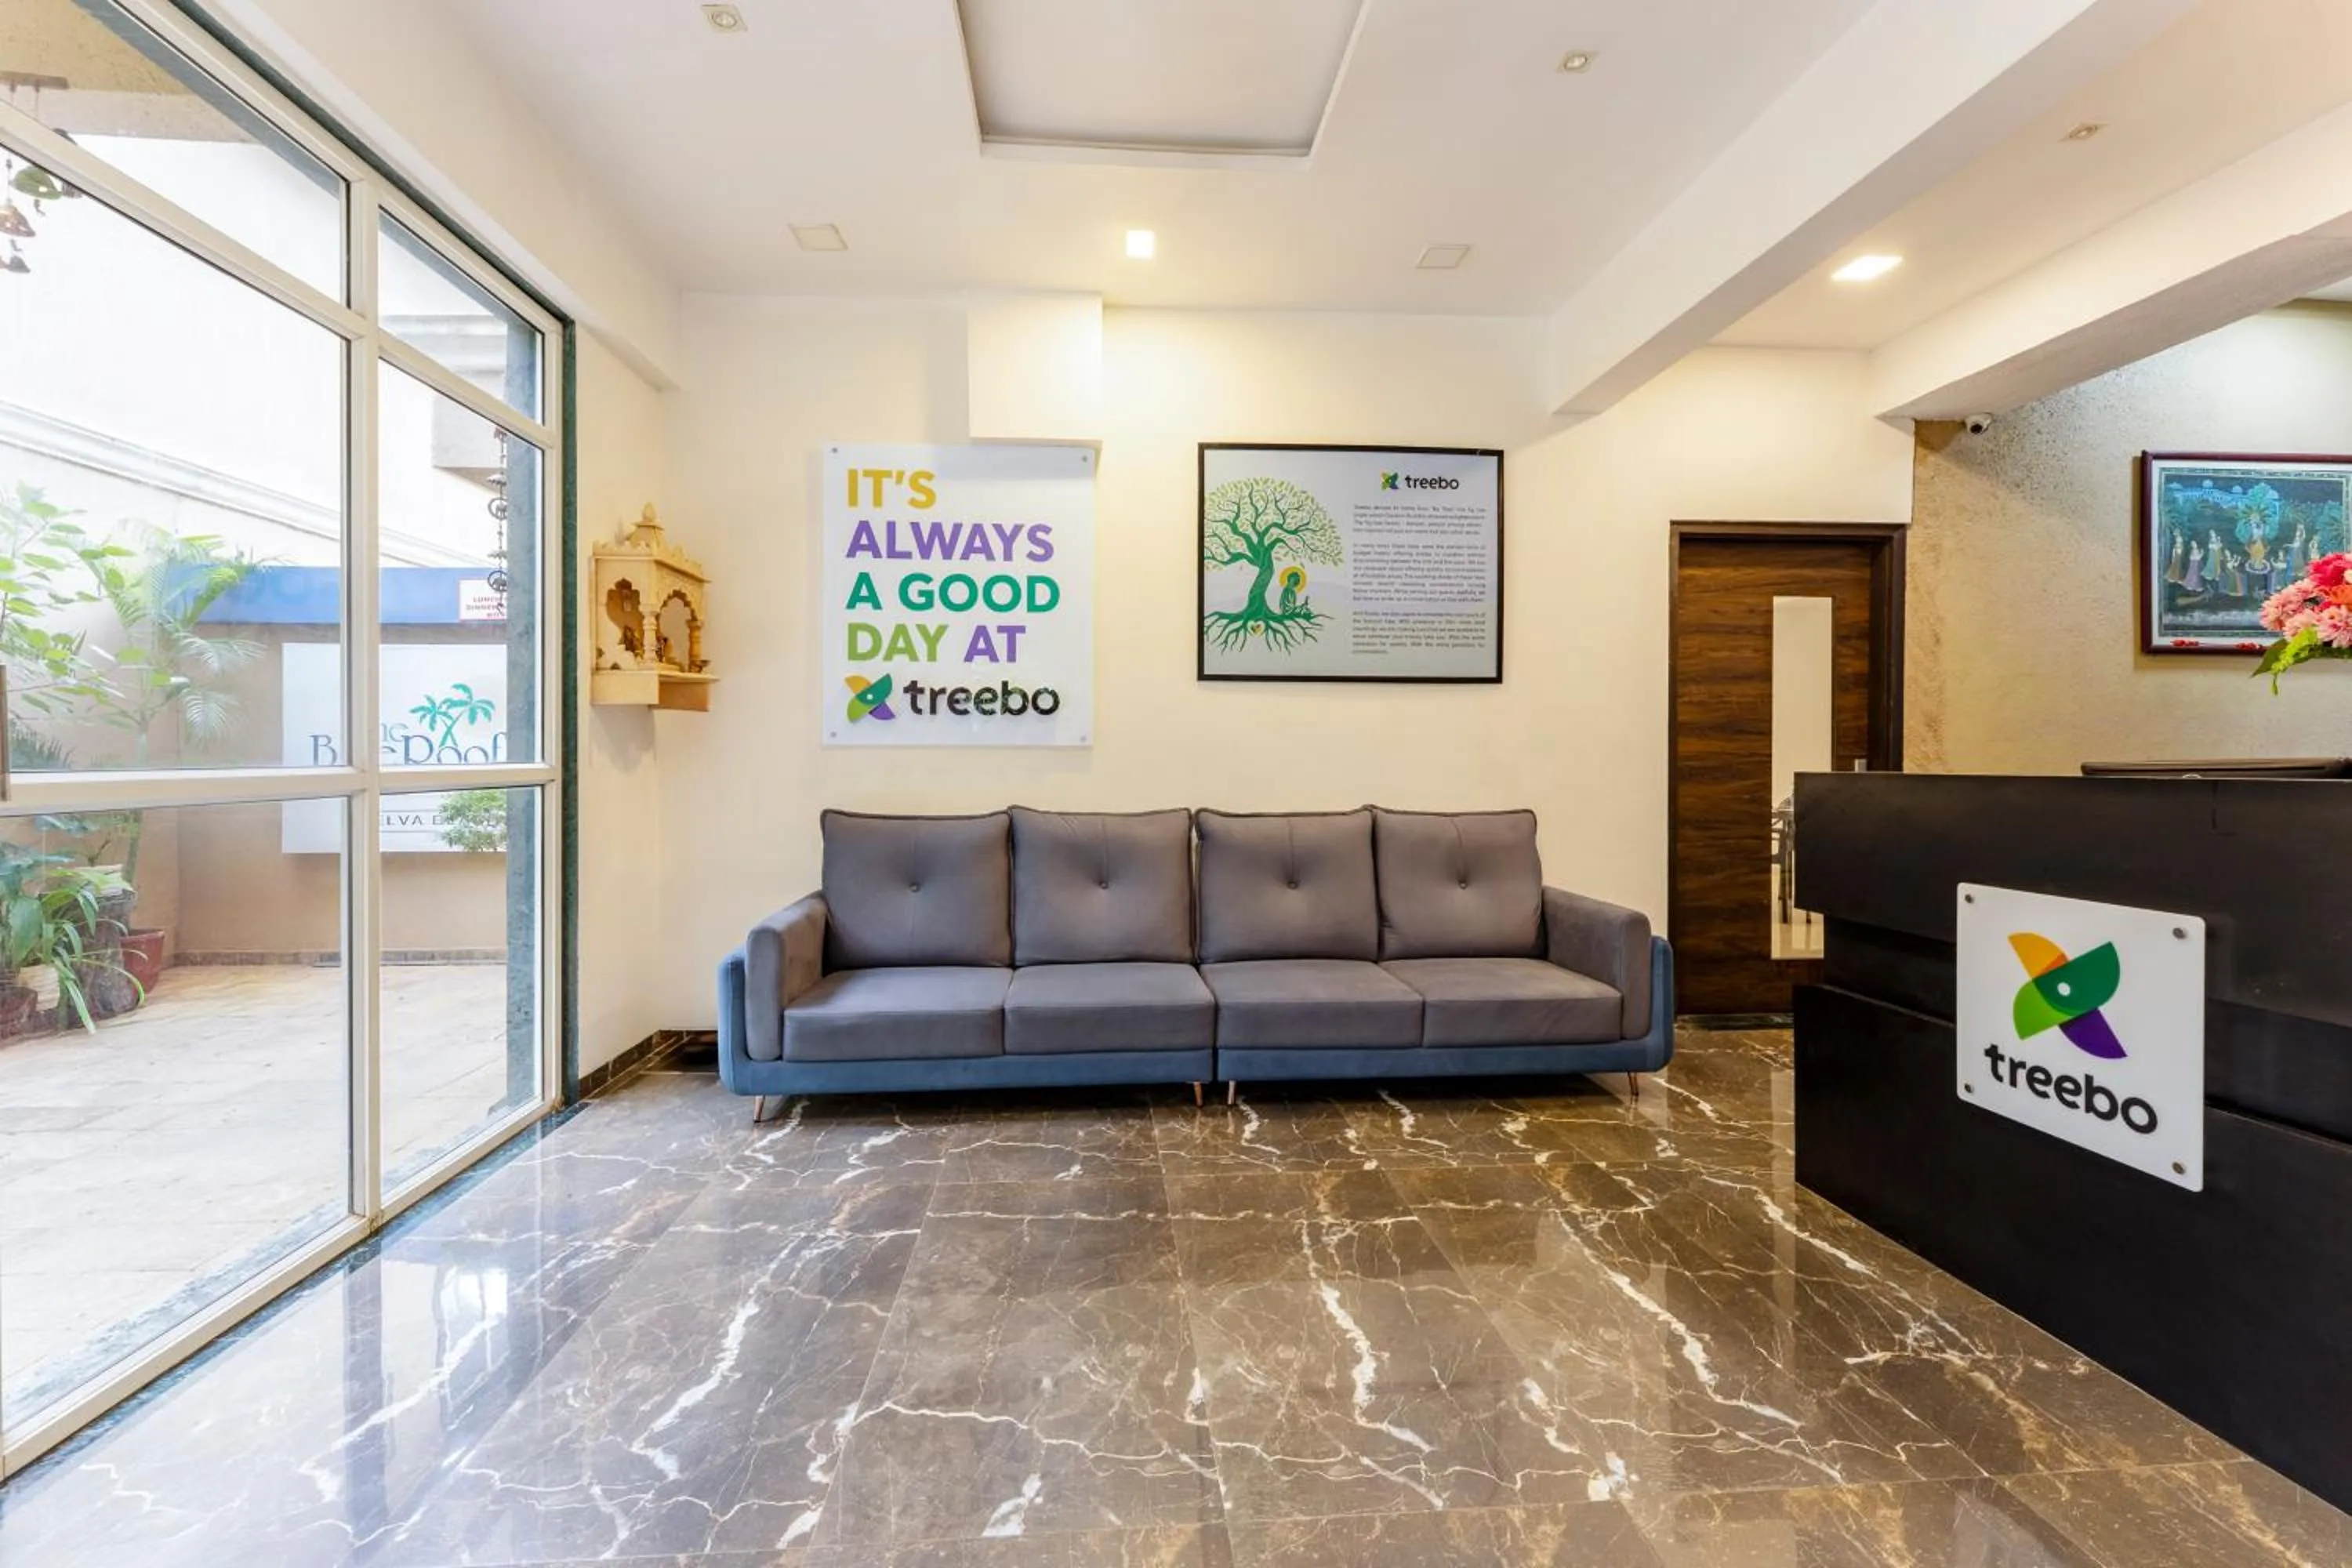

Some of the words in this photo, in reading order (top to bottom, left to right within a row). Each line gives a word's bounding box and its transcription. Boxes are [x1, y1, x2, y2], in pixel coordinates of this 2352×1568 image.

[847, 468, 937, 509] IT'S
[1404, 475, 1460, 490] treebo
[845, 520, 1055, 562] ALWAYS
[845, 572, 883, 610] A
[898, 572, 1061, 613] GOOD
[847, 622, 949, 662] DAY
[964, 625, 1026, 663] AT
[903, 680, 1061, 717] treebo
[1984, 1044, 2158, 1134] treebo
